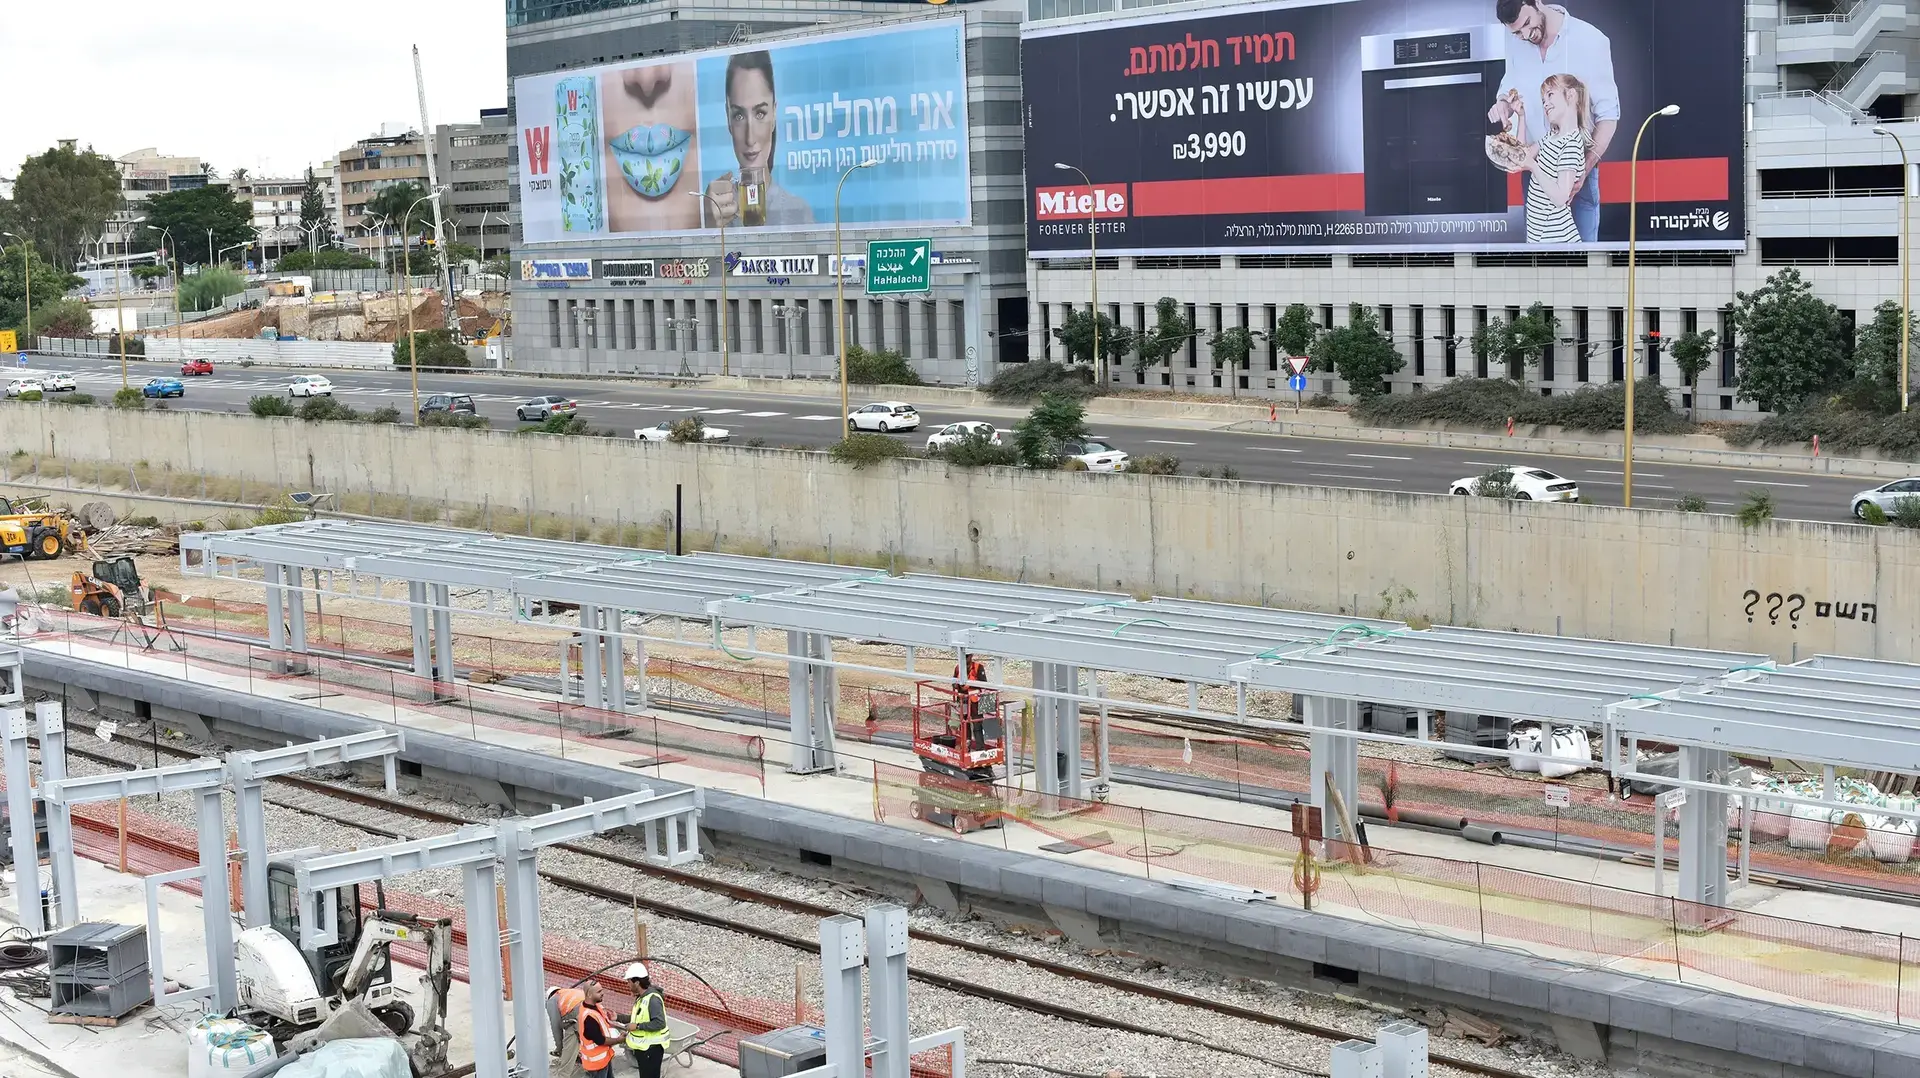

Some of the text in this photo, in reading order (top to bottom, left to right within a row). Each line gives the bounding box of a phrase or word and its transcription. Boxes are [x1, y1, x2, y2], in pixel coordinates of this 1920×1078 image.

[1123, 31, 1296, 77] תמיד חלמתם.
[1109, 77, 1314, 123] עכשיו זה אפשרי.
[785, 90, 955, 143] אני מחליטה
[525, 126, 549, 175] W
[787, 138, 957, 174] סדרת חליטות הגן הקסום
[528, 180, 552, 192] ויסוצקי
[1038, 189, 1125, 215] Miele
[1695, 207, 1710, 215] מבית
[1039, 222, 1126, 235] FOREVER BETTER
[1364, 222, 1388, 235] מדגם
[1390, 220, 1412, 234] מילה
[1413, 219, 1439, 233] לתנור
[1441, 220, 1475, 233] מתייחס
[1477, 219, 1507, 232] המחיר
[1650, 212, 1710, 231] אלקטרה
[1224, 223, 1255, 237] הרצליה.
[1276, 222, 1296, 236] מילה
[1297, 223, 1322, 236] בחנות
[876, 248, 906, 259] ההלכה
[603, 263, 653, 277] BOMBARDIER
[741, 259, 778, 274] BAKER
[780, 258, 815, 274] TILLY
[873, 274, 923, 285] HaHalacha
[1814, 601, 1877, 624] השם
